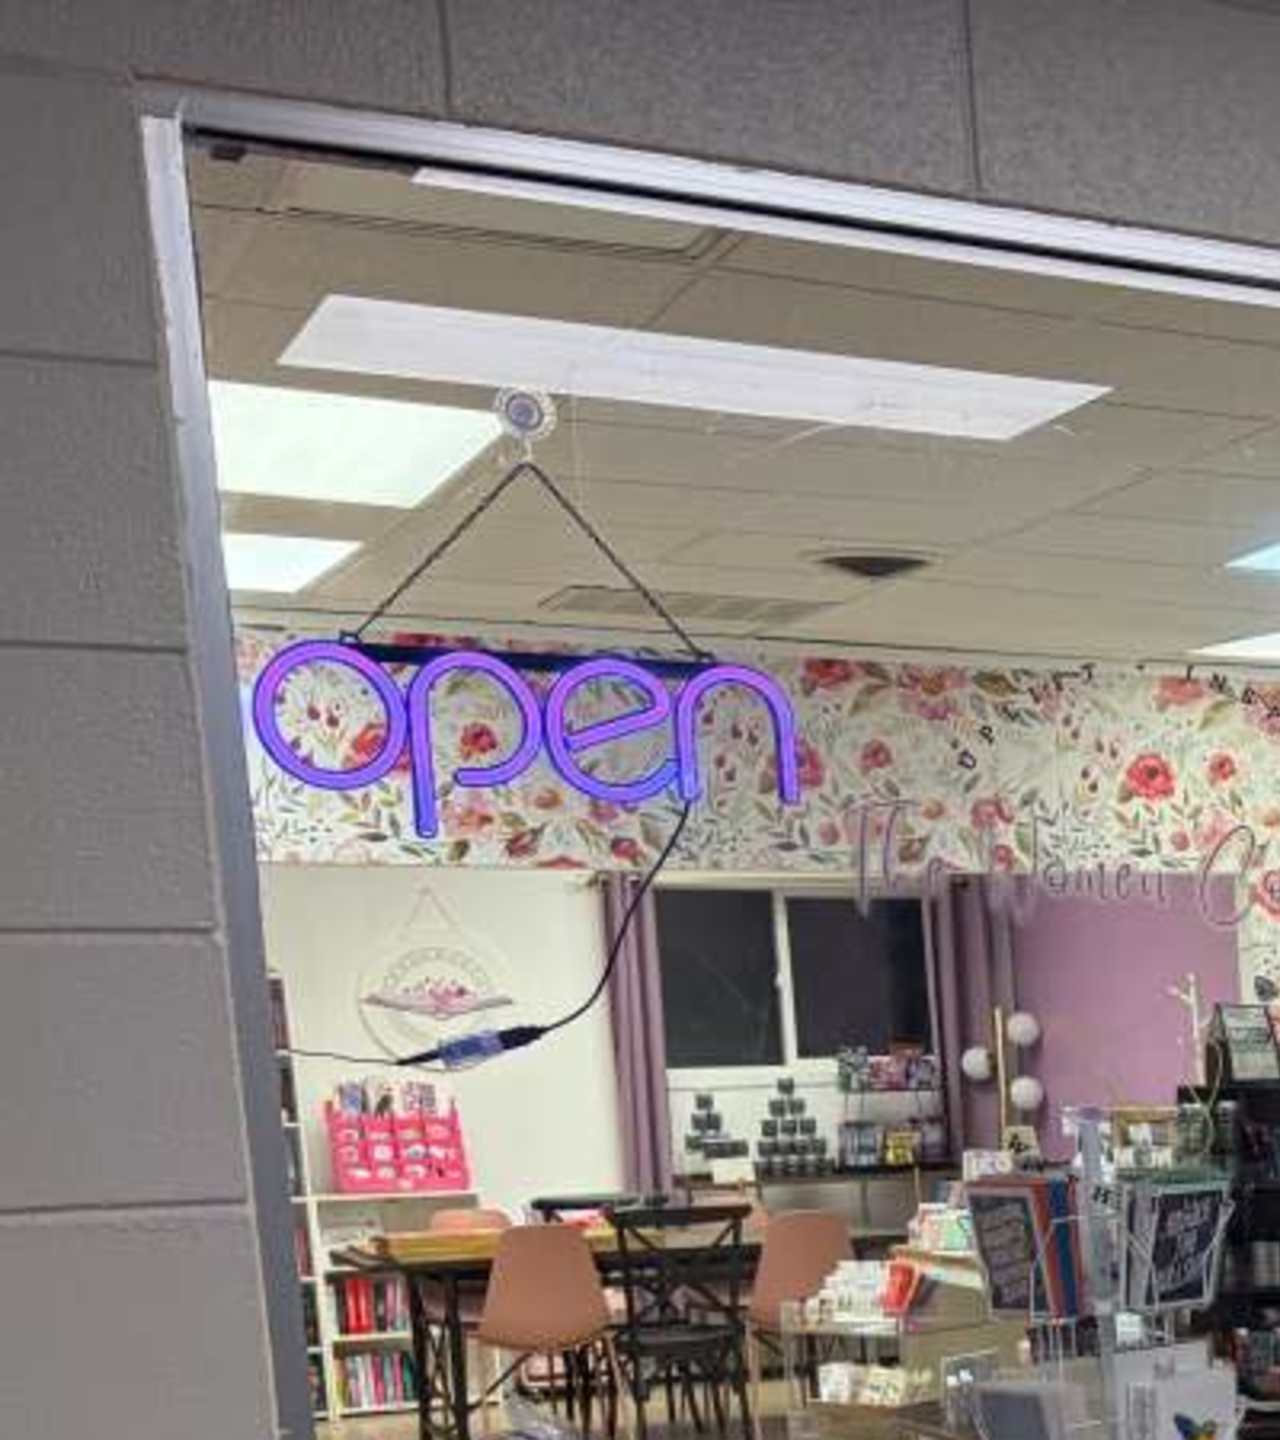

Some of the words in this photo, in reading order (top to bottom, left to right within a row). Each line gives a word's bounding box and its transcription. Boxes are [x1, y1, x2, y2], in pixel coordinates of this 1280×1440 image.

[253, 638, 801, 839] open
[846, 797, 962, 915] The
[980, 805, 1170, 925] Women
